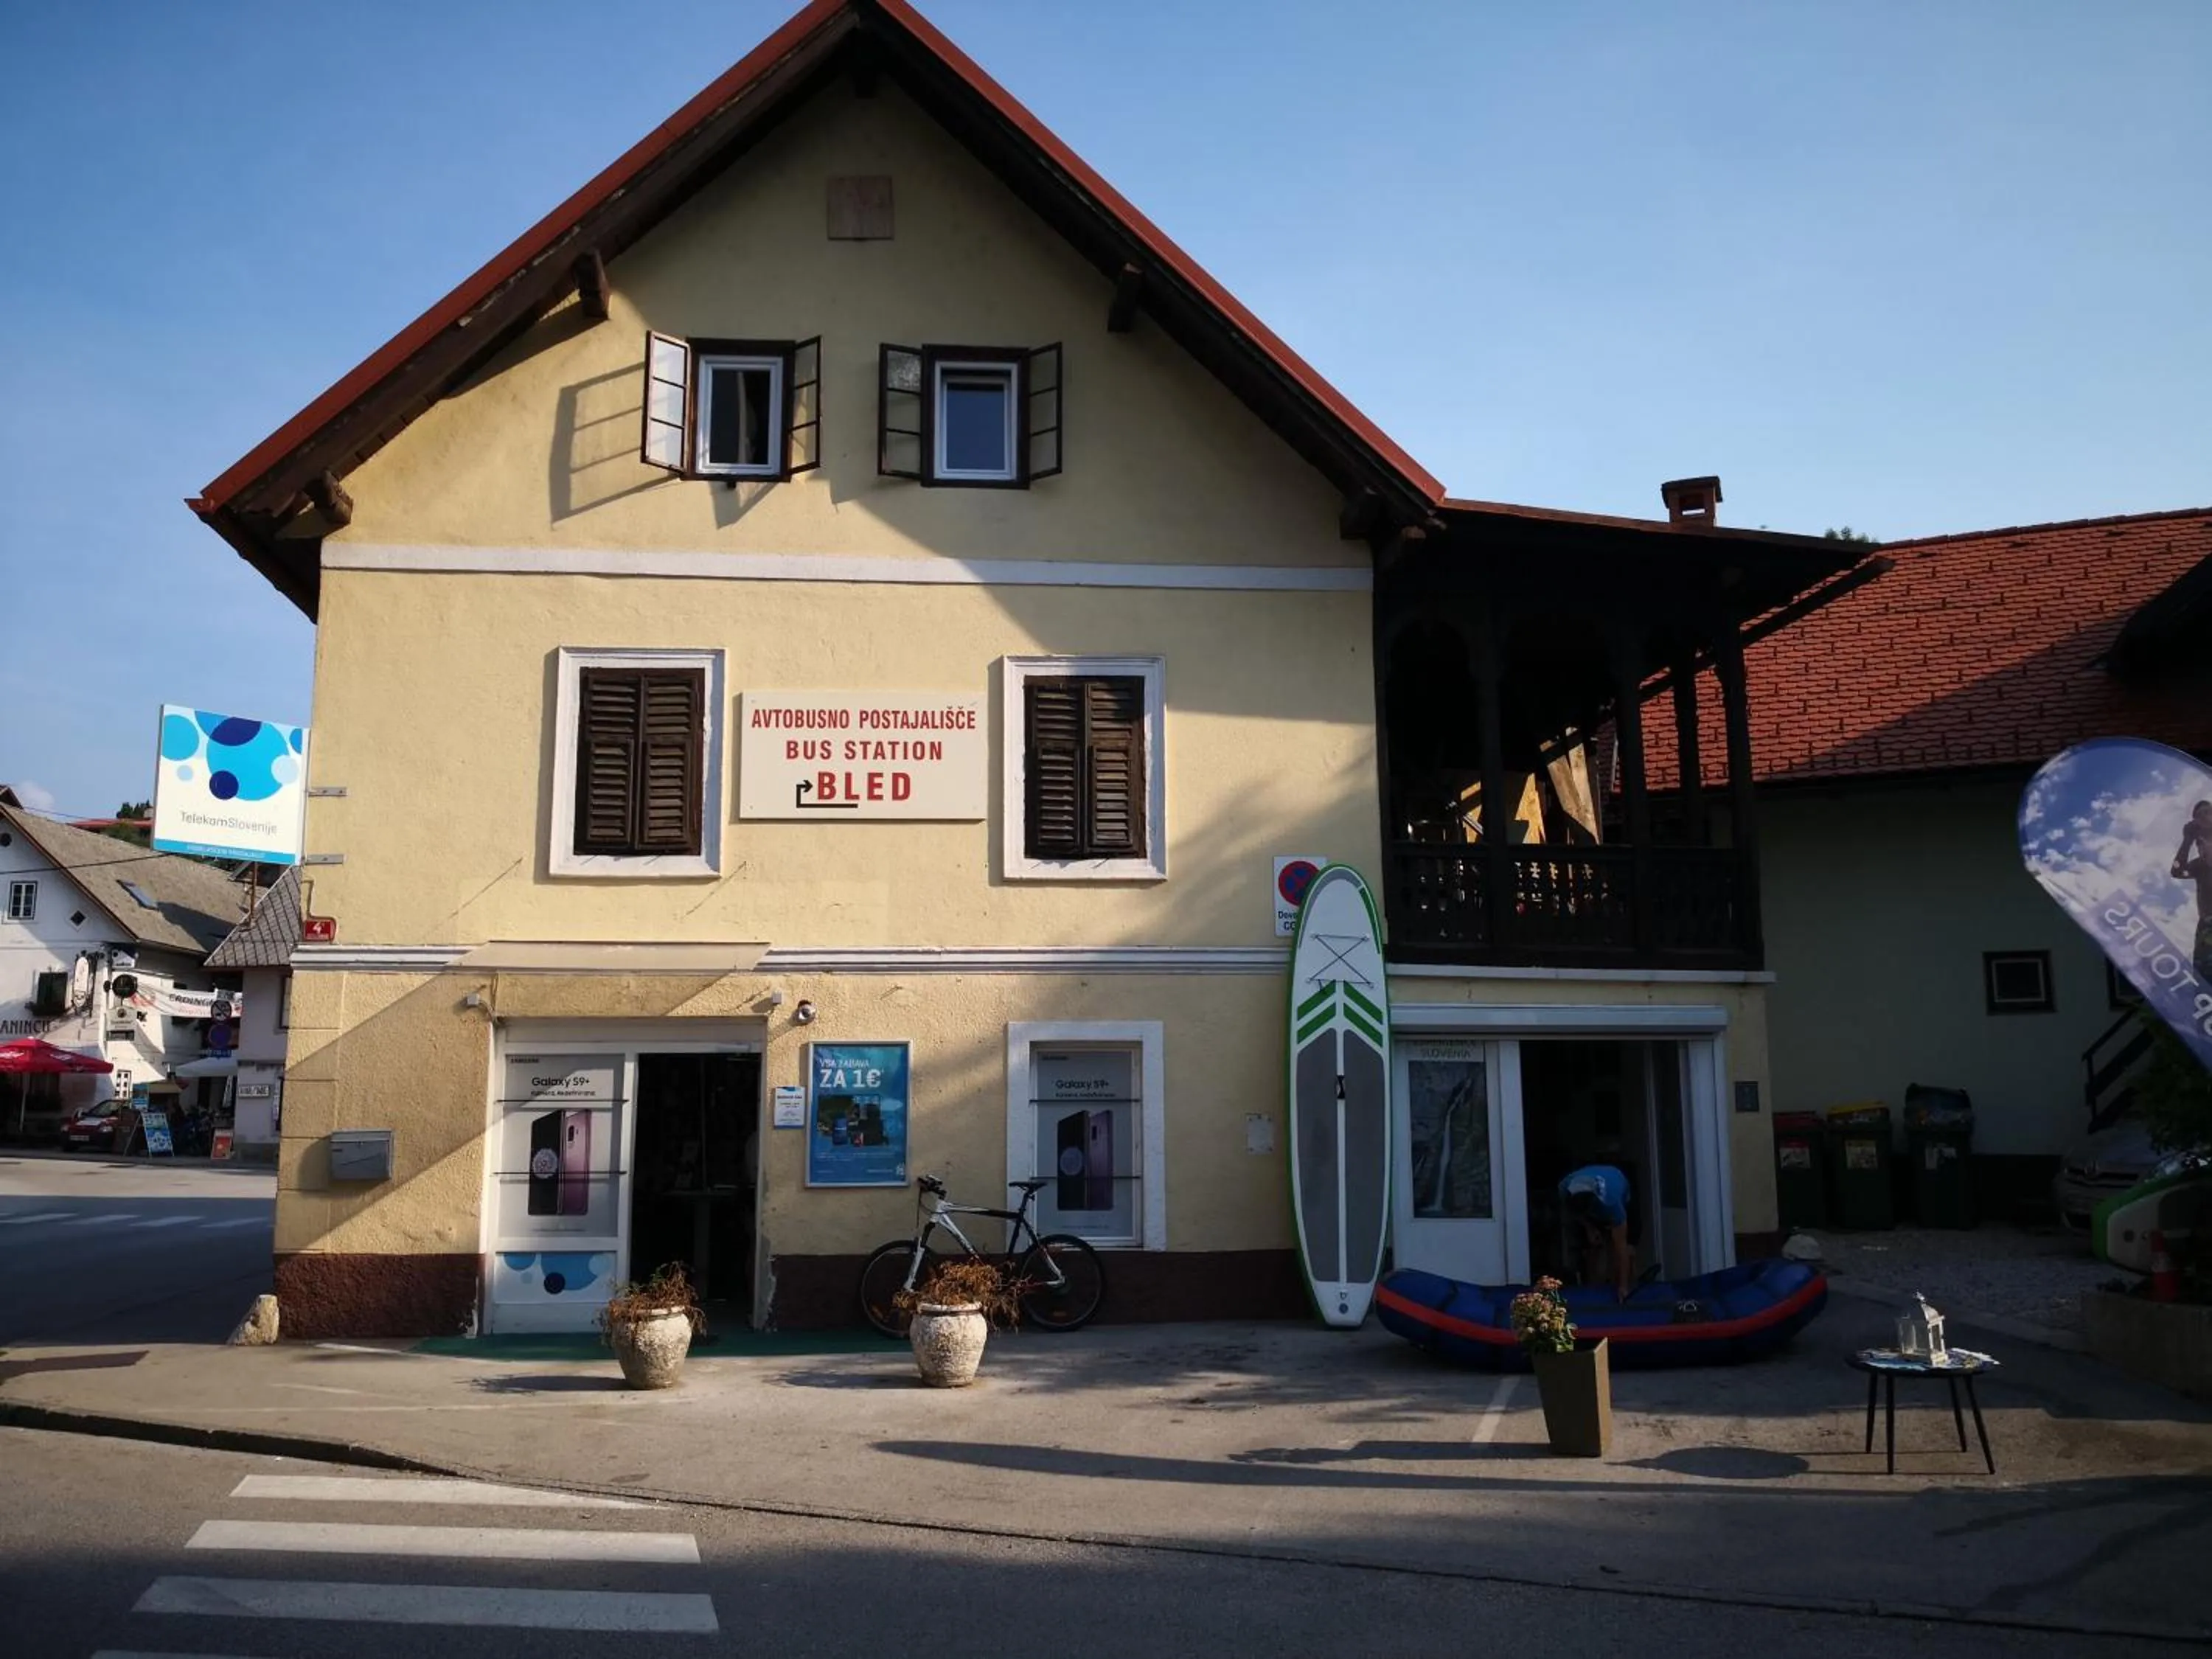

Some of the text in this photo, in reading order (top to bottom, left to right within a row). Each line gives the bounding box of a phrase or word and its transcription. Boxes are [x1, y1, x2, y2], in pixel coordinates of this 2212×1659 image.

[751, 706, 976, 729] AVTOBUSNO POSTAJALIŠČE
[786, 740, 942, 760] BUS STATION
[817, 771, 911, 801] BLED
[180, 811, 278, 835] TelekomSlovenije
[532, 1077, 590, 1088] Galaxy S9+
[819, 1068, 848, 1088] ZA
[1055, 1079, 1109, 1091] Galaxy S9+
